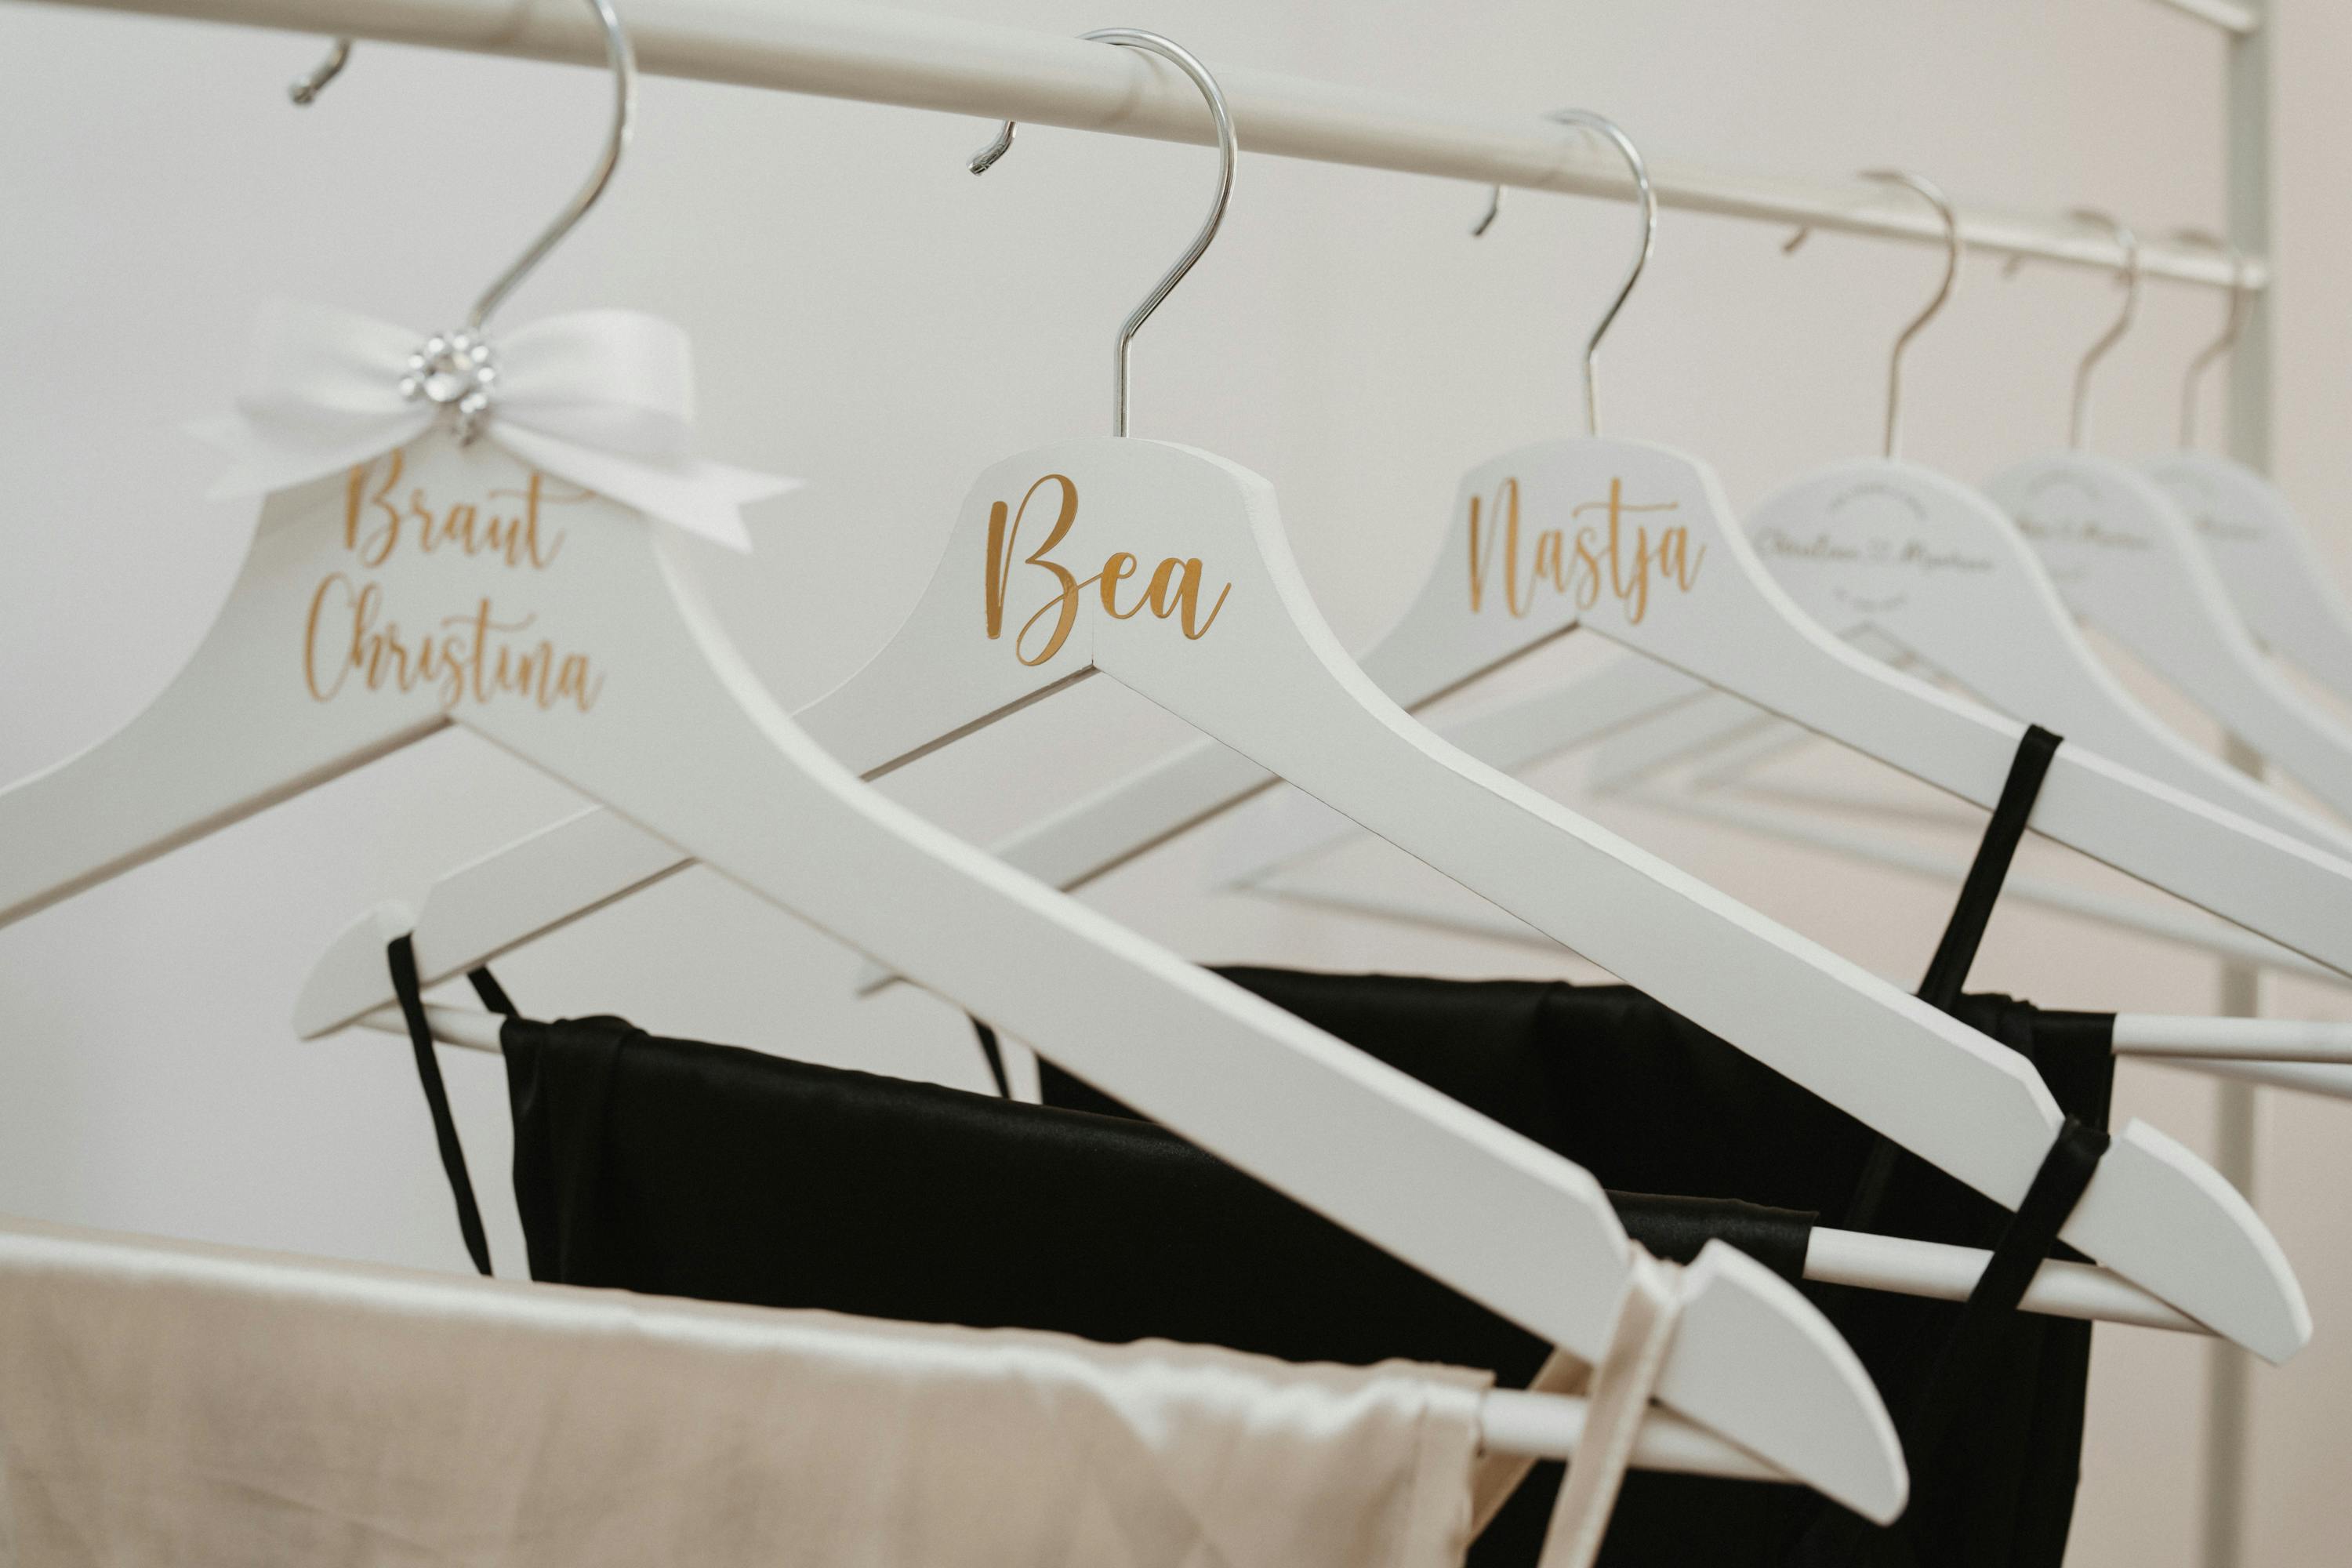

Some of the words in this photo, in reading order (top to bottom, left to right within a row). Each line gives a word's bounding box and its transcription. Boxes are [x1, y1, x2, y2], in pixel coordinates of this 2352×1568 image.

[345, 445, 599, 569] Braut
[985, 473, 1232, 666] Bea
[1468, 477, 1708, 626] Nastja
[303, 571, 607, 713] Christina
